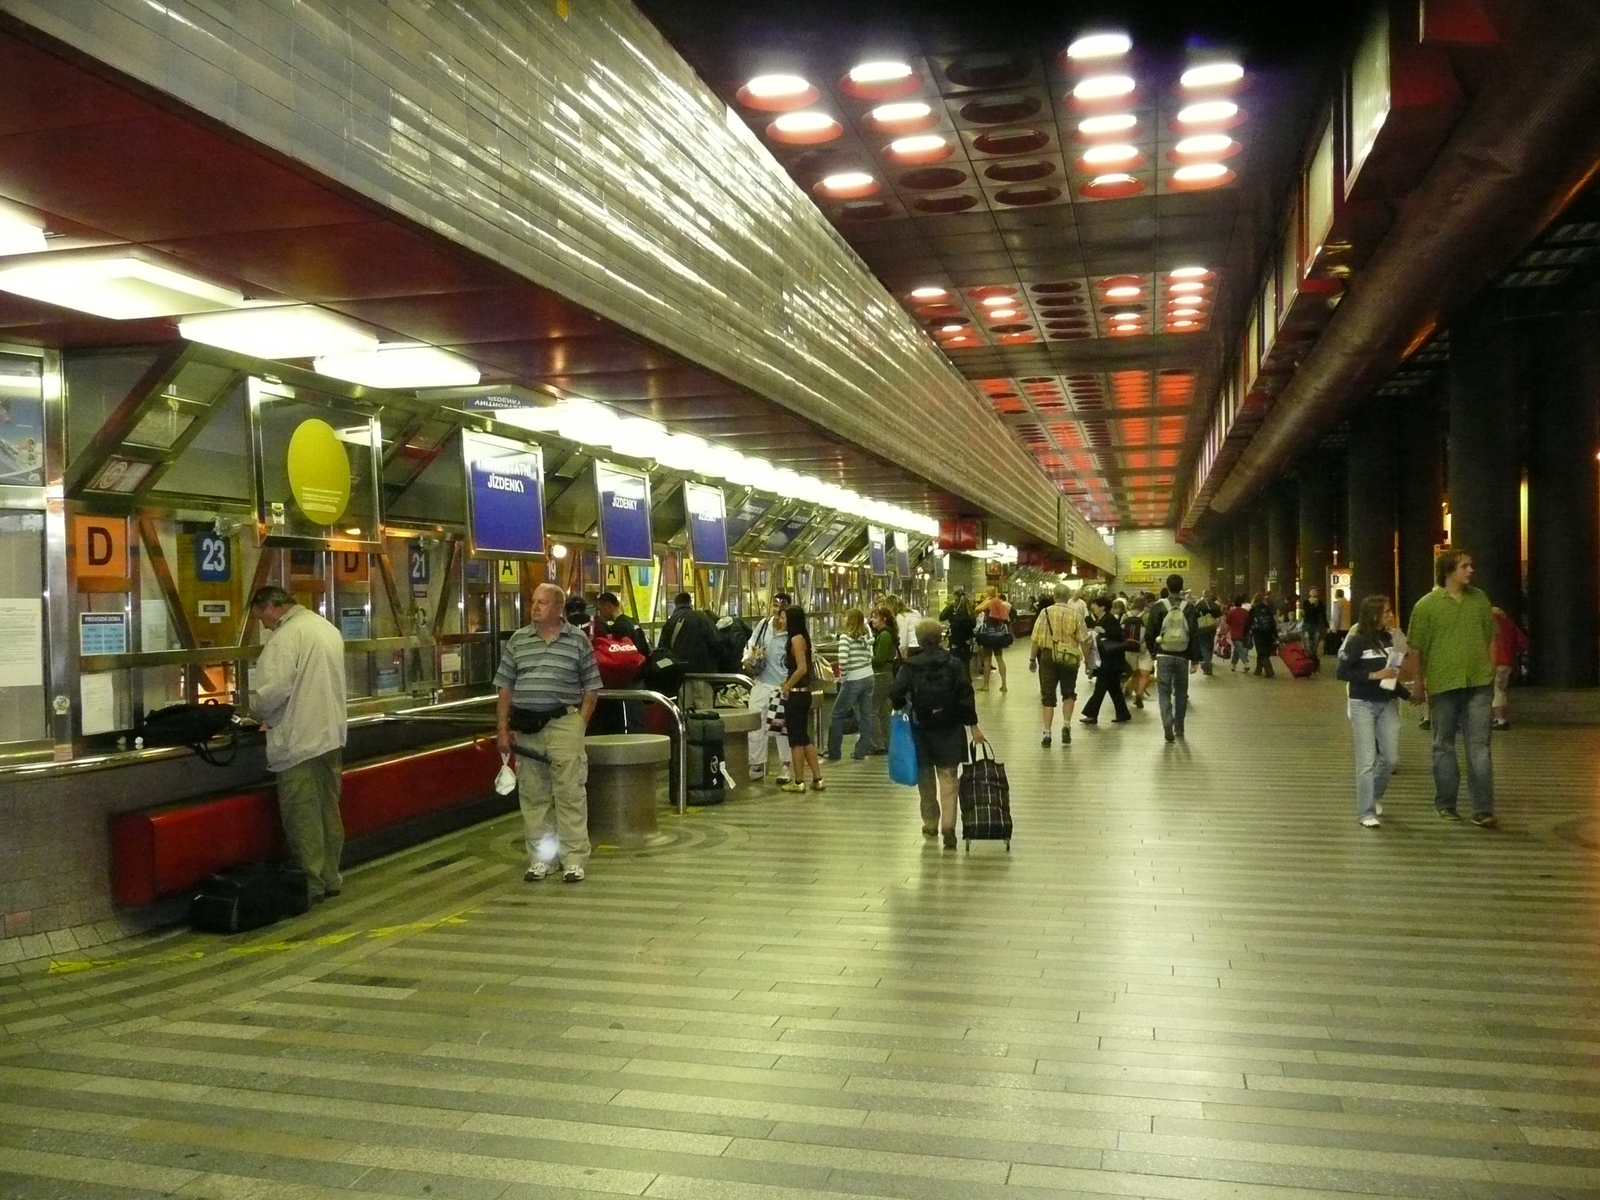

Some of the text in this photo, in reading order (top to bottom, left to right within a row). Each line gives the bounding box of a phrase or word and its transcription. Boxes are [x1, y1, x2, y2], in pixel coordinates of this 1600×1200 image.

[487, 472, 524, 493] JÍZDENKY
[87, 526, 113, 566] D
[202, 538, 226, 571] 23
[412, 553, 426, 578] 21
[501, 559, 513, 576] A
[547, 560, 557, 581] 19
[608, 565, 616, 579] A
[684, 562, 691, 580] A
